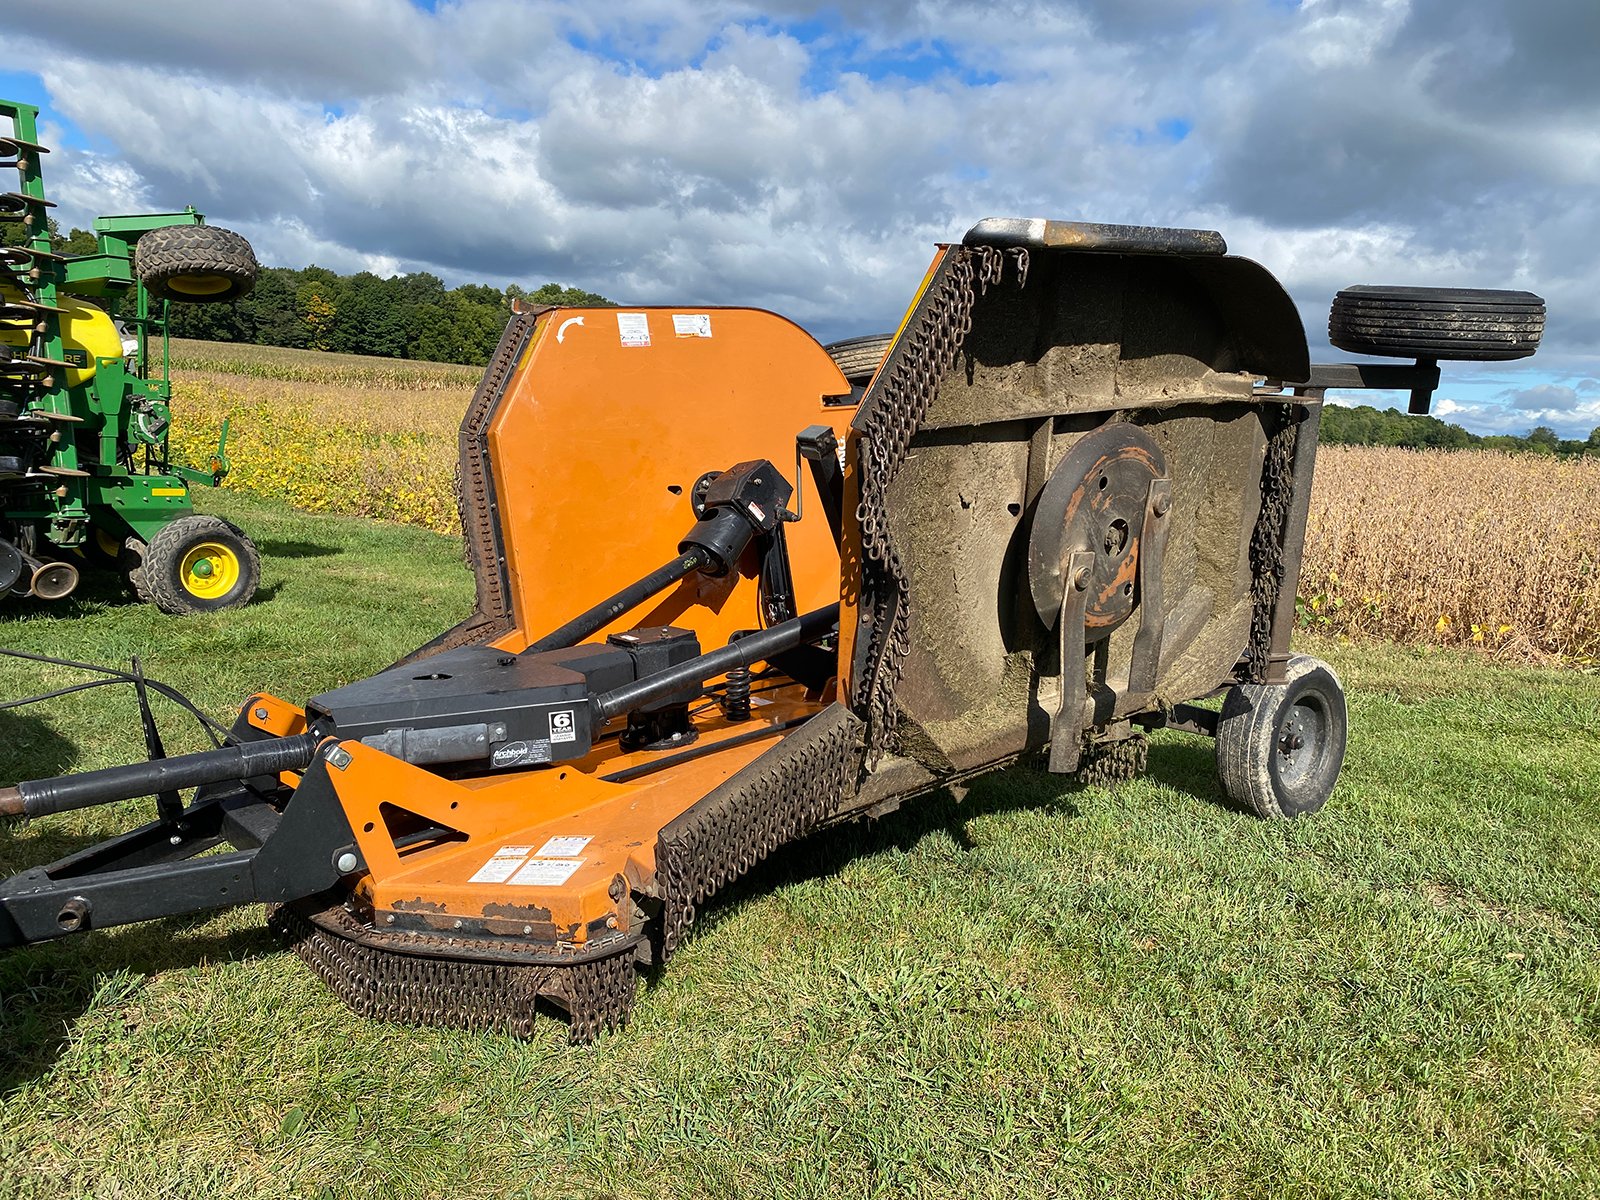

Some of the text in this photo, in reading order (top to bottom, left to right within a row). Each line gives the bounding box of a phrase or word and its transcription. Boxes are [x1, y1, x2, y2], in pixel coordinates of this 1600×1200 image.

[553, 713, 571, 728] 6
[552, 726, 572, 734] YEAR
[493, 747, 528, 757] Archbold
